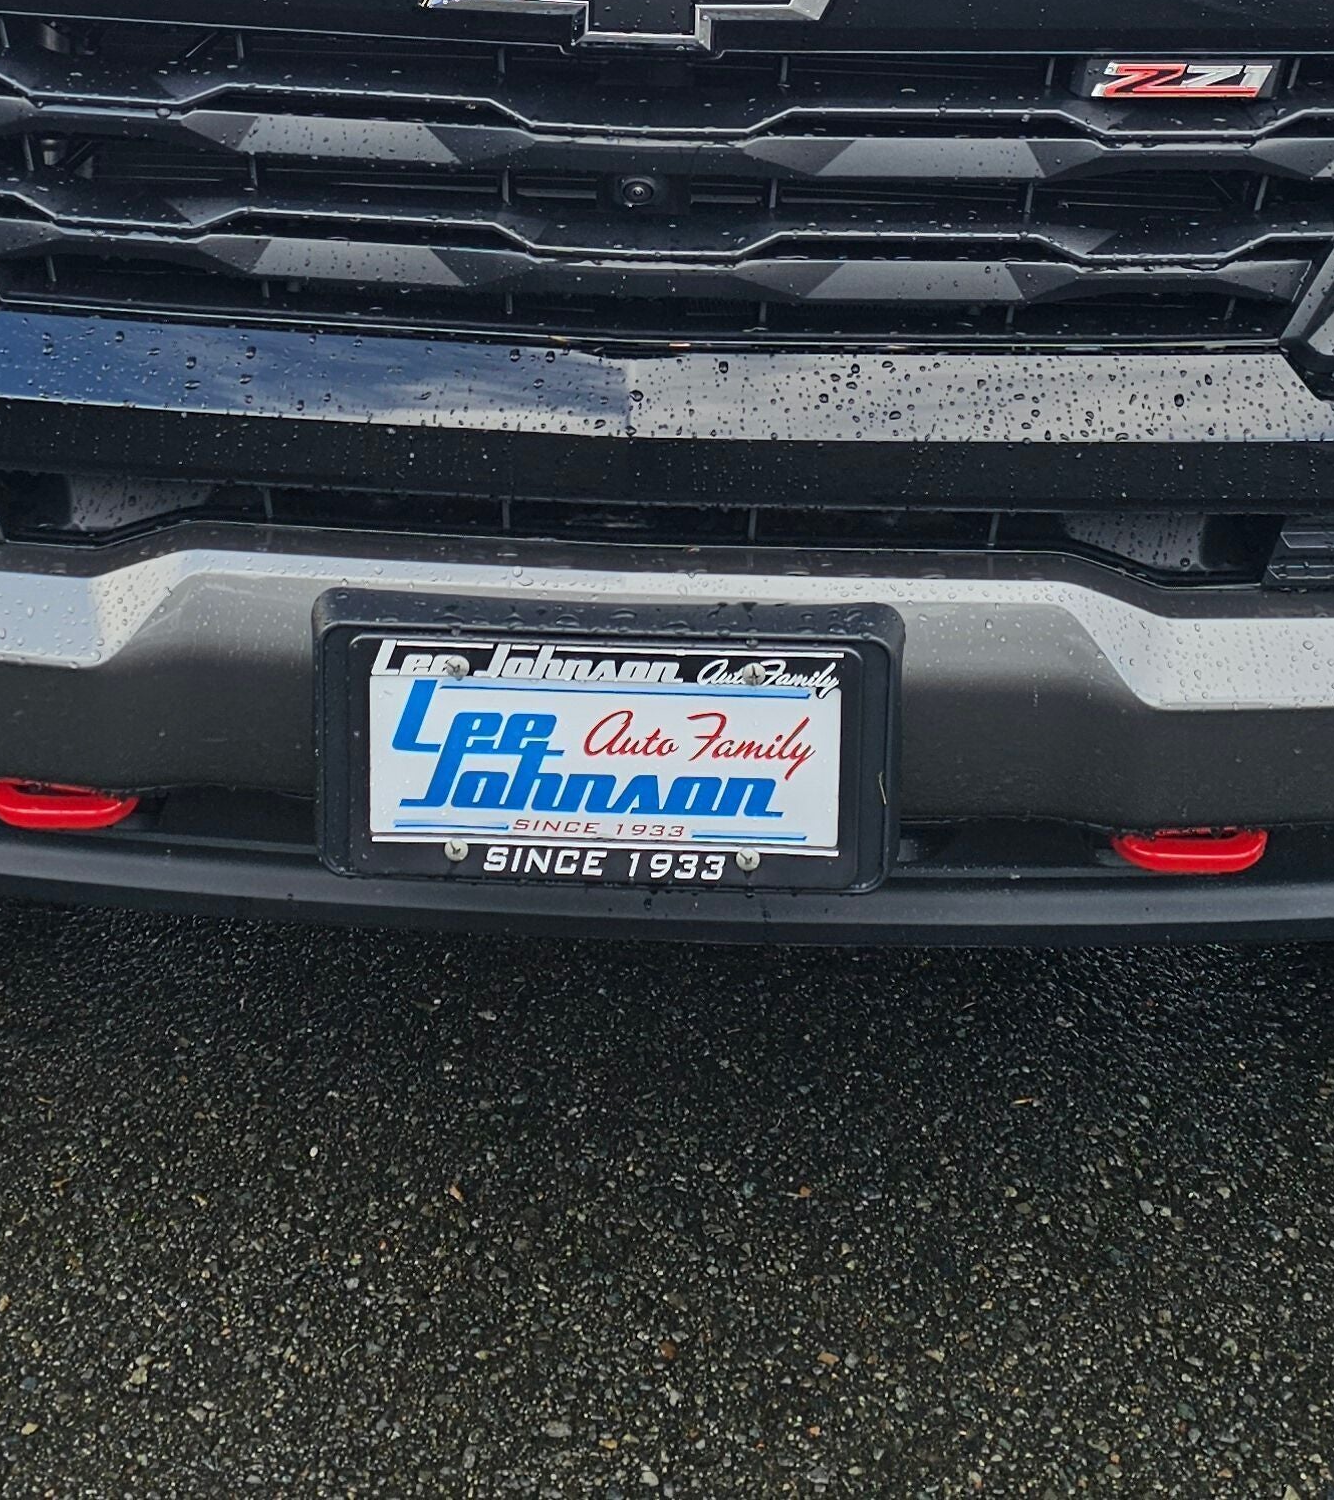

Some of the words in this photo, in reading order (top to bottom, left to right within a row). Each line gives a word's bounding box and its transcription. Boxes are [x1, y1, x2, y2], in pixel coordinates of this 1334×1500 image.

[1091, 62, 1273, 98] Z71
[473, 642, 684, 684] Johnson
[696, 659, 752, 686] Aut
[760, 659, 839, 699] Family
[392, 680, 564, 756] Lee
[583, 710, 680, 758] Auto
[683, 711, 815, 781] Family
[399, 746, 784, 818] Johnson
[513, 818, 602, 834] SINCE
[615, 823, 686, 840] 1933
[482, 846, 608, 877] SINCE
[625, 850, 725, 881] 1933
